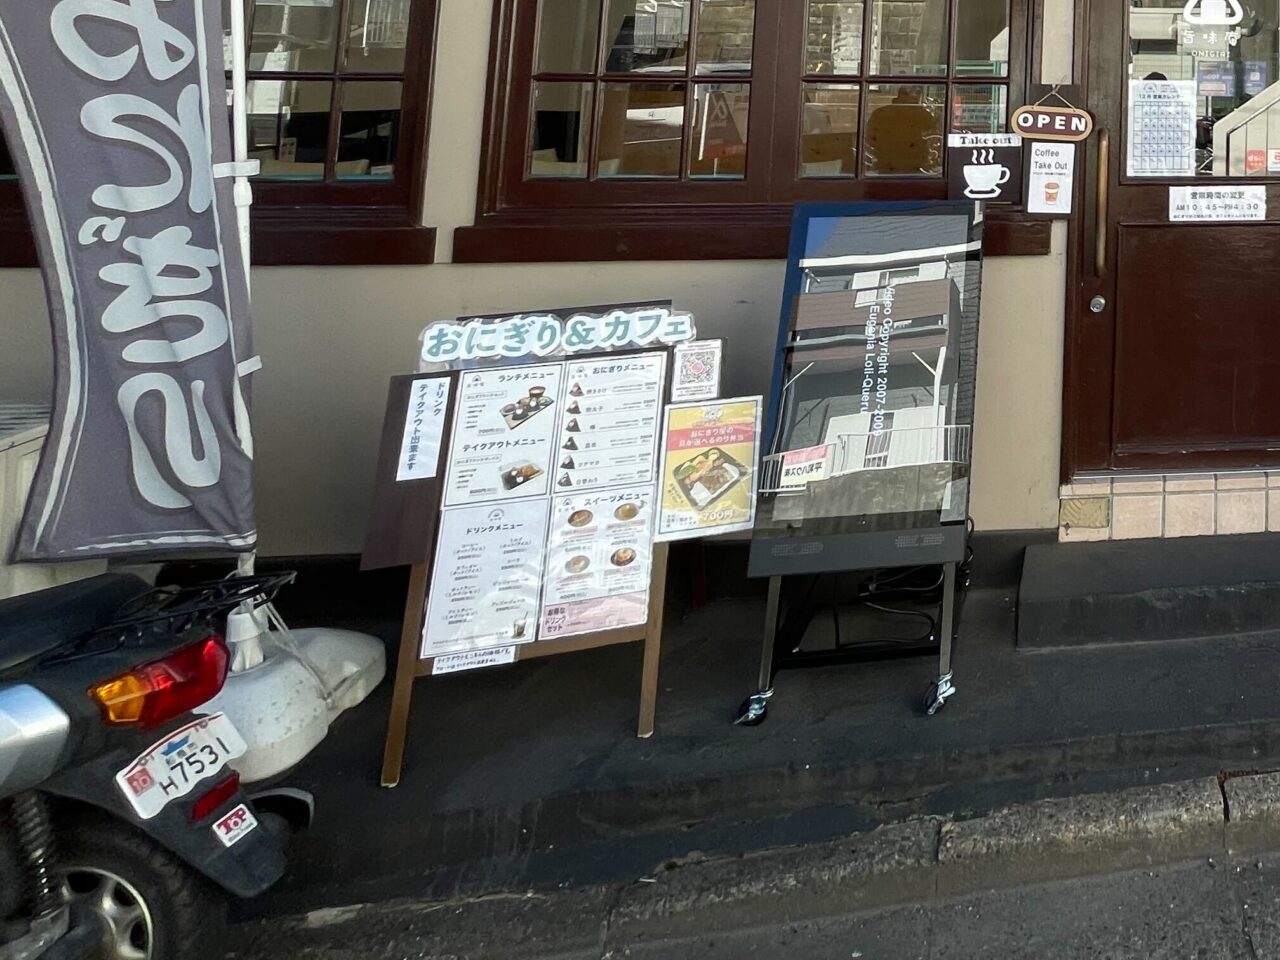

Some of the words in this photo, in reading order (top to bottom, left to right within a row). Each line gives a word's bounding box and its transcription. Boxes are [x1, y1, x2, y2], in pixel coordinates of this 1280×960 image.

[1017, 113, 1087, 132] OPEN
[960, 136, 989, 145] Take
[1034, 148, 1060, 158] Coffee
[1034, 161, 1052, 170] Take
[1054, 161, 1068, 170] Out
[882, 286, 895, 315] Video
[426, 313, 691, 357] おにぎり&カフェ
[866, 305, 880, 350] Eugenia
[877, 319, 893, 374] Copyright
[498, 372, 555, 382] ランチメニュー
[592, 364, 655, 375] おにぎりメニュー
[433, 382, 446, 416] ドリンク
[873, 377, 888, 437] 2007-2009
[462, 438, 546, 452] テイクアウトメニュー
[584, 492, 650, 506] スイーツメニュー
[466, 523, 524, 535] ドリンクメニュー
[170, 736, 230, 783] 7531
